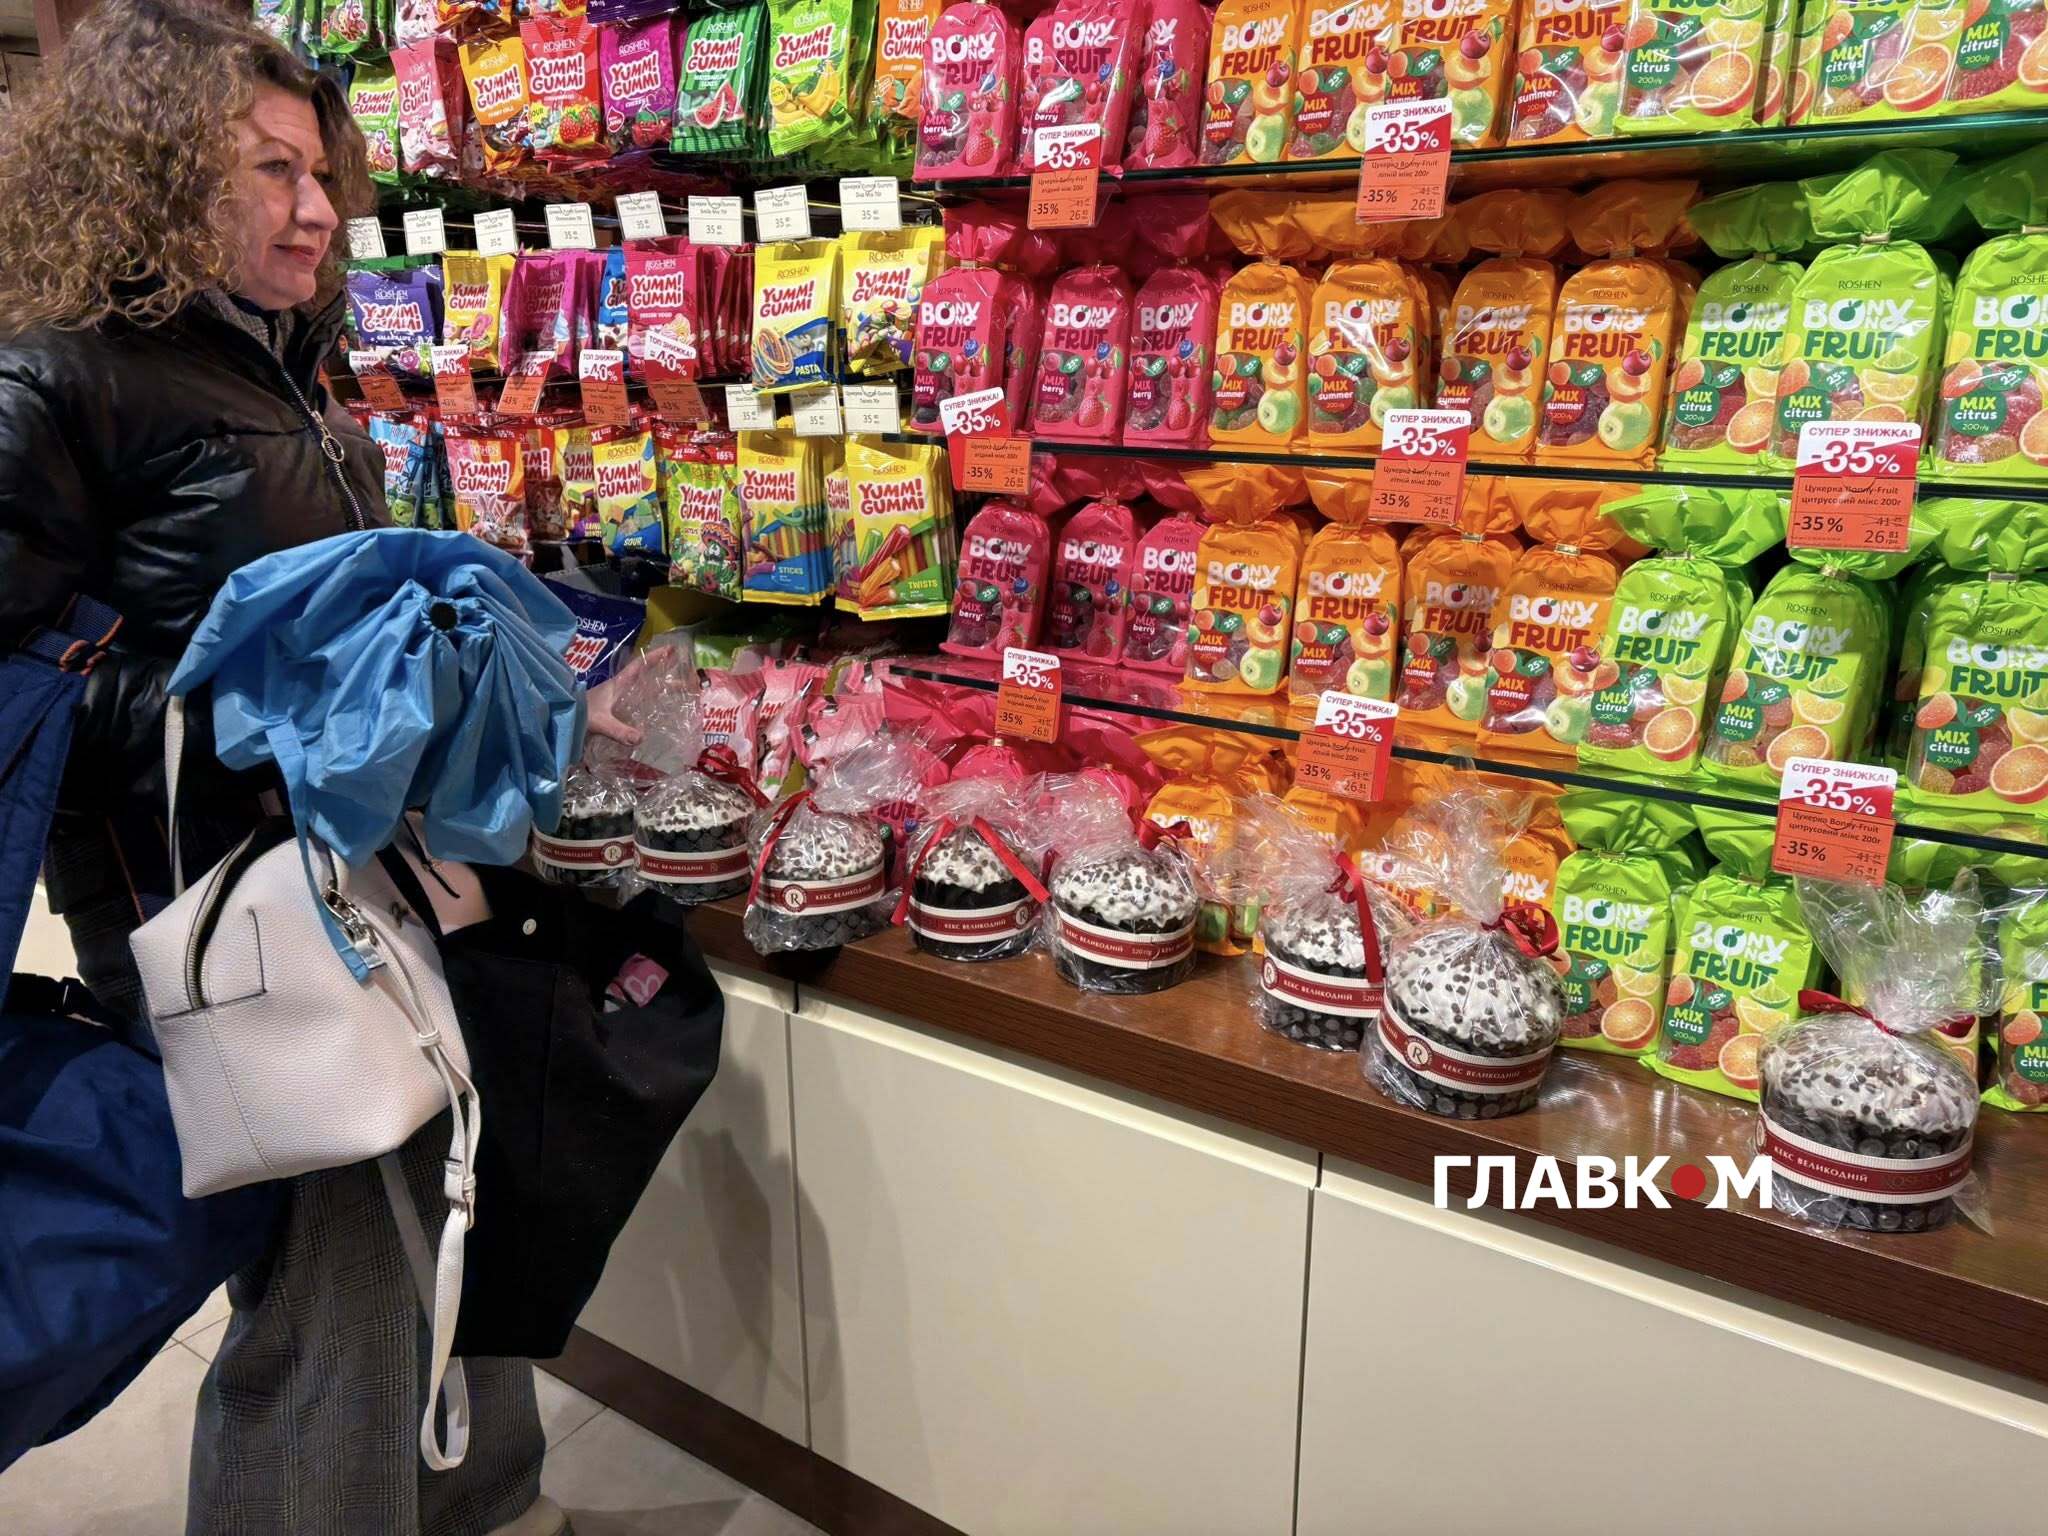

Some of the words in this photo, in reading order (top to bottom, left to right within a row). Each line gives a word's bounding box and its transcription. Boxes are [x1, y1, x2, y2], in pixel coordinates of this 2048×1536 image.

[1966, 22, 2000, 39] MIX
[1831, 44, 1863, 60] MIX
[1961, 38, 1999, 54] citrus
[1636, 48, 1670, 62] MIX
[1632, 62, 1670, 74] citrus
[1826, 60, 1864, 74] citrus
[1524, 77, 1553, 92] MIX
[1518, 89, 1558, 104] summer
[1304, 98, 1328, 111] MIX
[1035, 112, 1058, 122] berry
[1298, 108, 1332, 122] summer
[1372, 110, 1400, 120] СУПЕР
[1403, 105, 1446, 117] ЗНИЖКА!
[924, 125, 947, 135] berry
[1206, 120, 1233, 129] summer
[1376, 121, 1440, 153] -35%
[1042, 142, 1090, 169] -35%
[795, 364, 820, 375] PASTA
[915, 385, 934, 394] berry
[1042, 384, 1064, 395] berry
[1324, 380, 1348, 391] MIX
[1444, 386, 1468, 396] MIX
[1133, 390, 1151, 399] berry
[1216, 390, 1245, 398] summer
[1318, 391, 1354, 400] summer
[1438, 396, 1471, 404] summer
[1554, 390, 1580, 402] MIX
[1684, 391, 1712, 404] MIX
[944, 400, 966, 411] СУПЕР
[1546, 402, 1584, 410] summer
[1680, 402, 1712, 412] citrus
[1789, 395, 1820, 409] MIX
[1960, 396, 1996, 410] MIX
[1390, 414, 1419, 423] СУПЕР
[1421, 416, 1464, 424] ЗНИЖКА!
[1784, 408, 1822, 418] citrus
[1955, 408, 1997, 420] citrus
[952, 408, 1000, 434] -35%
[1808, 426, 1850, 436] СУПЕР
[1853, 428, 1912, 438] ЗНИЖКА!
[1393, 427, 1456, 456] -35%
[1812, 441, 1900, 474] -35%
[1864, 530, 1885, 543] 26
[908, 580, 937, 589] TWISTS
[958, 611, 982, 621] berry
[1132, 624, 1154, 634] berry
[1194, 645, 1227, 654] summer
[1303, 647, 1326, 658] MIX
[1296, 658, 1332, 666] summer
[1010, 664, 1054, 690] -35%
[1405, 669, 1434, 678] summer
[1498, 678, 1524, 692] MIX
[1490, 689, 1529, 700] summer
[1600, 692, 1628, 705] MIX
[1326, 696, 1352, 706] СУПЕР
[1354, 701, 1392, 714] ЗНИЖКА!
[1596, 703, 1628, 712] citrus
[1726, 704, 1755, 720] MIX
[1326, 710, 1382, 742] -35%
[1720, 716, 1754, 729] citrus
[1934, 729, 1970, 744] MIX
[1930, 742, 1970, 755] citrus
[1792, 764, 1830, 774] СУПЕР
[1832, 768, 1888, 782] ЗНИЖКА!
[1794, 778, 1876, 815] -35%
[1674, 1008, 1704, 1024] MIX
[1668, 1018, 1704, 1034] citrus
[1774, 1146, 1794, 1162] КЕКС
